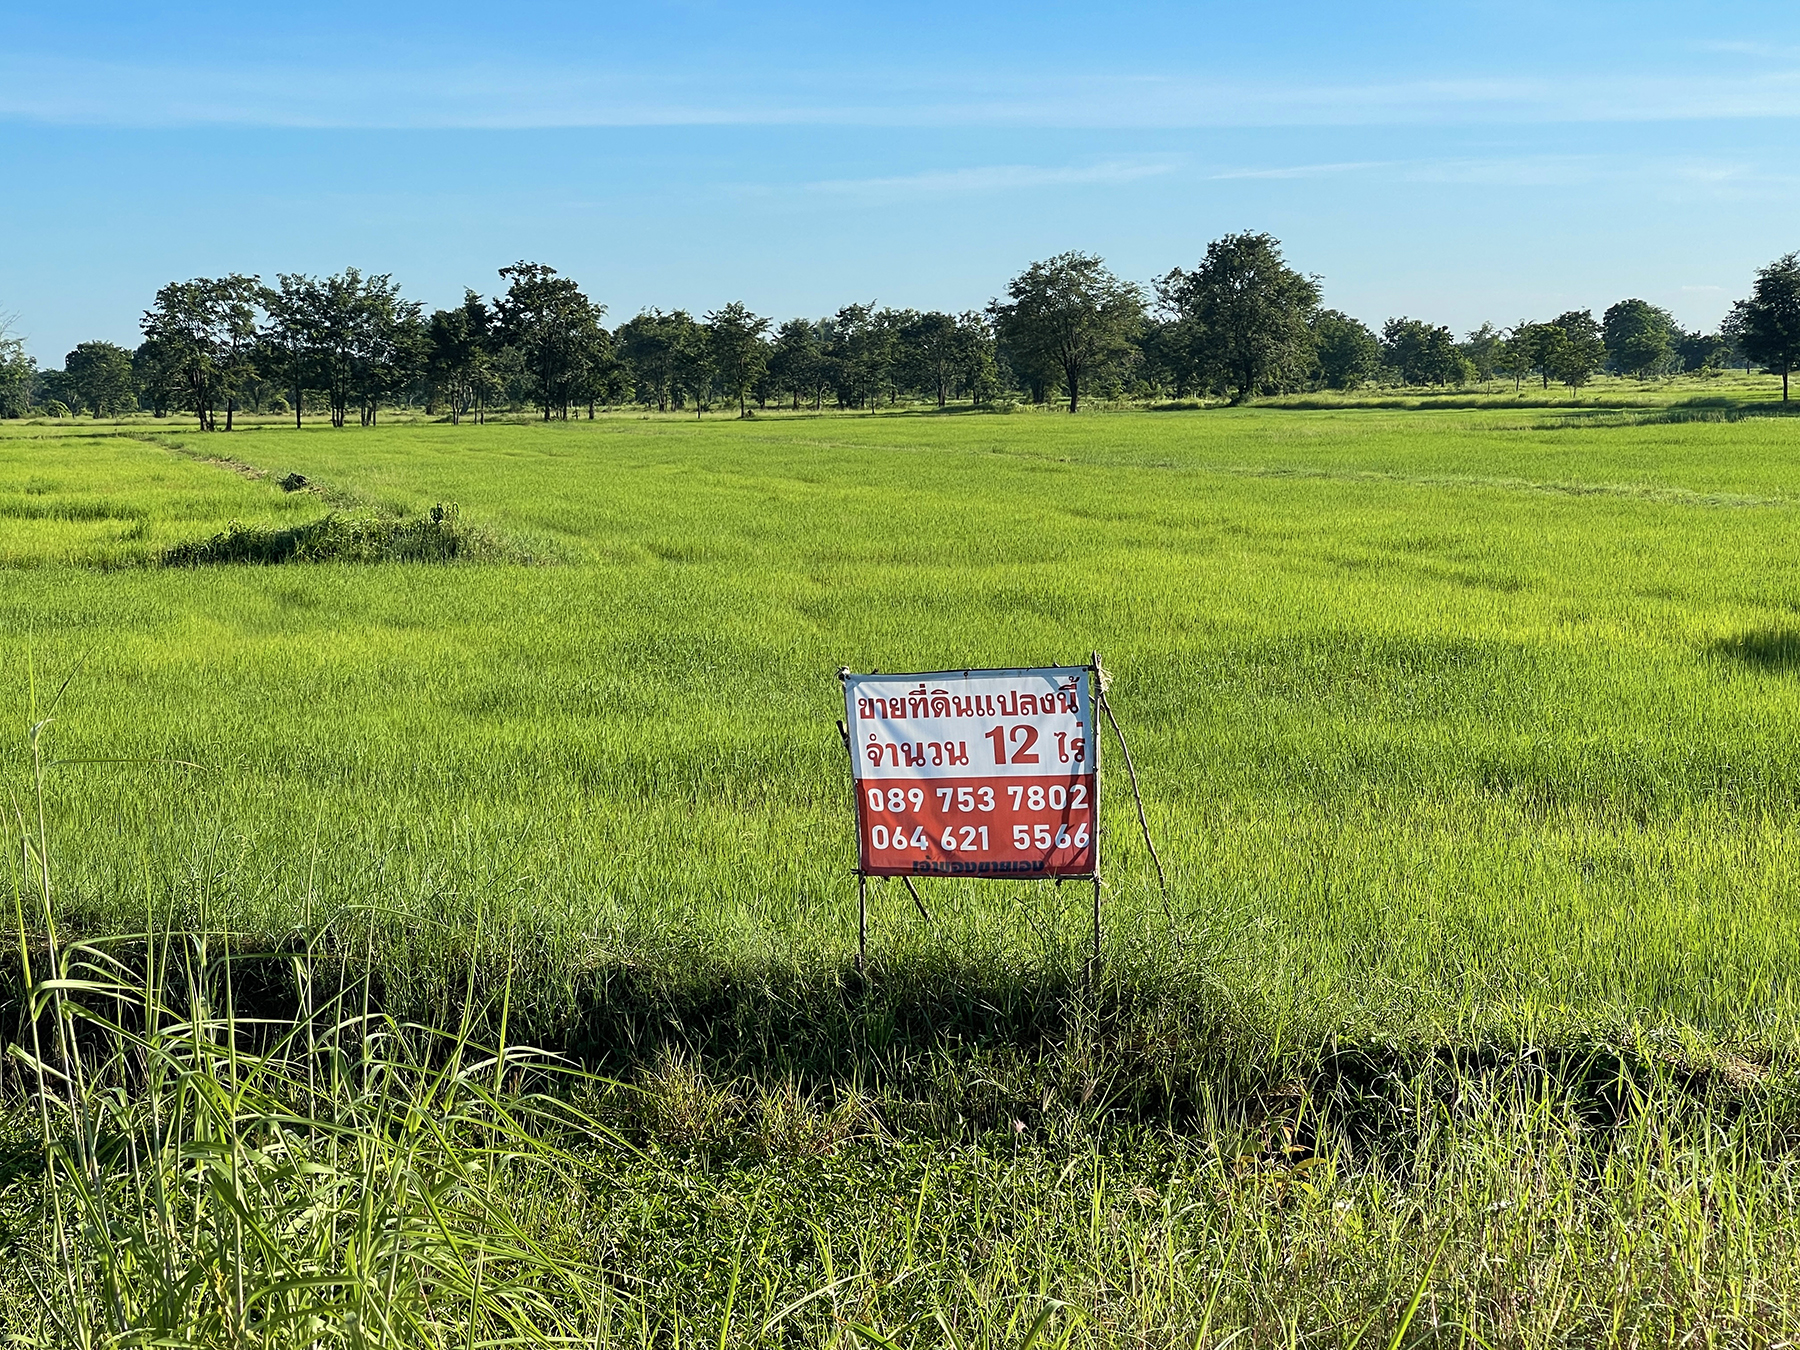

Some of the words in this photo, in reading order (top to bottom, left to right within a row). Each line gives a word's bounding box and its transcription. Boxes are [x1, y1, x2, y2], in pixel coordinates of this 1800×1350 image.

[858, 676, 1080, 720] ขายที่ดินแปลงนี้
[866, 733, 969, 768] จำนวน
[984, 724, 1040, 765] 12
[1053, 722, 1086, 763] ไร่
[867, 788, 924, 813] 089
[936, 786, 996, 813] 753
[1007, 784, 1089, 812] 7802
[871, 826, 929, 850] 064
[940, 825, 989, 851] 621
[1012, 823, 1090, 850] 5566
